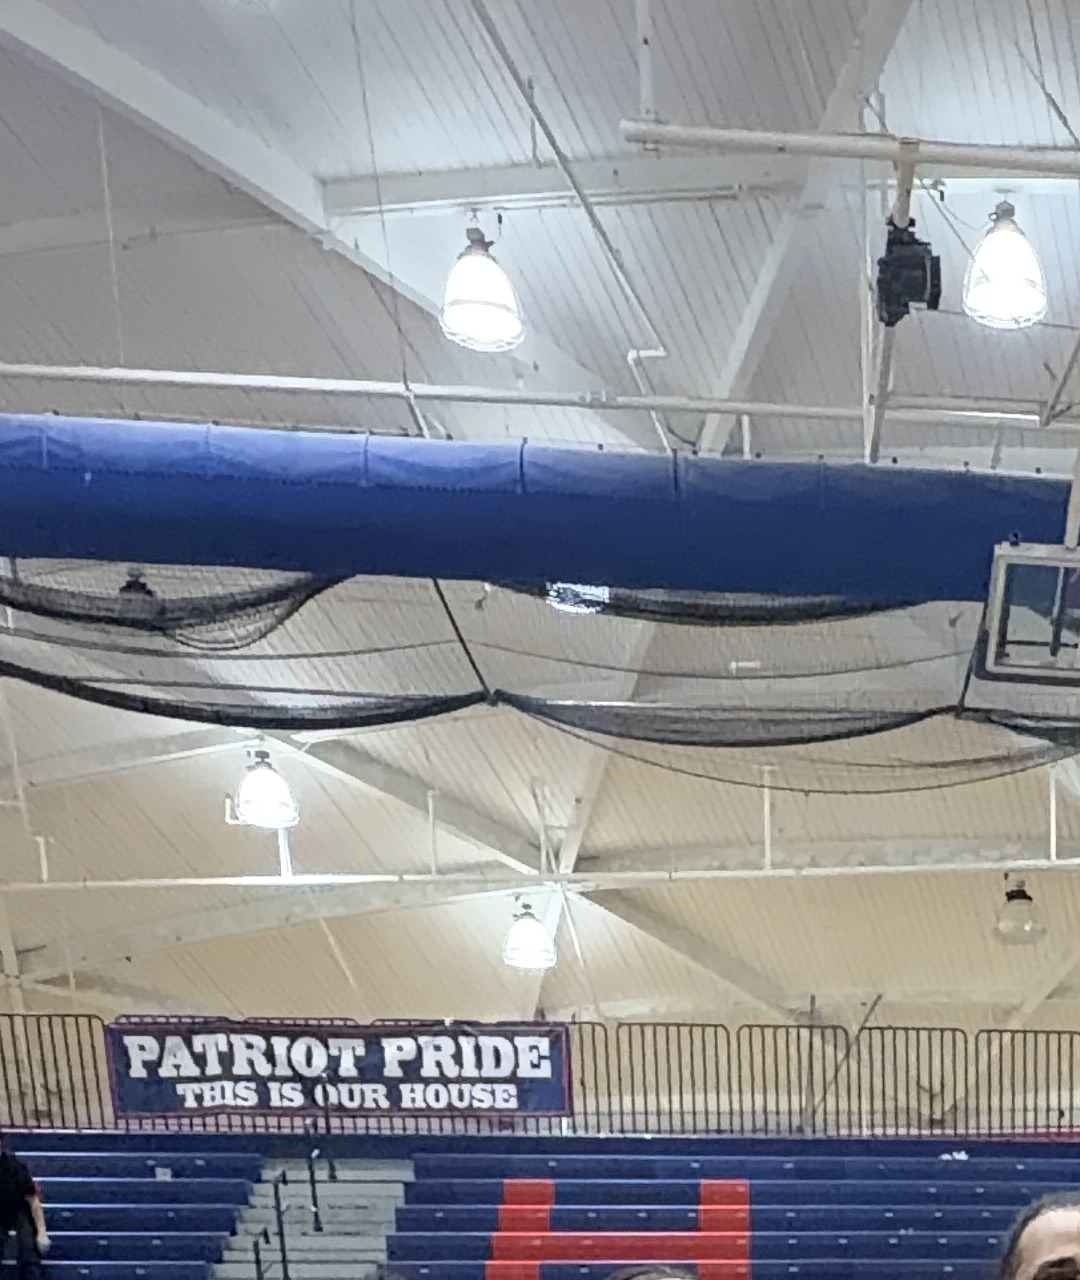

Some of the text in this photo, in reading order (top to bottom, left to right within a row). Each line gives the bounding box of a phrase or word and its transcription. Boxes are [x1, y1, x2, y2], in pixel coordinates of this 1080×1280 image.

[123, 1034, 552, 1079] PATRIOT PRIDE
[176, 1081, 518, 1109] THIS IS OUR HOUSE
